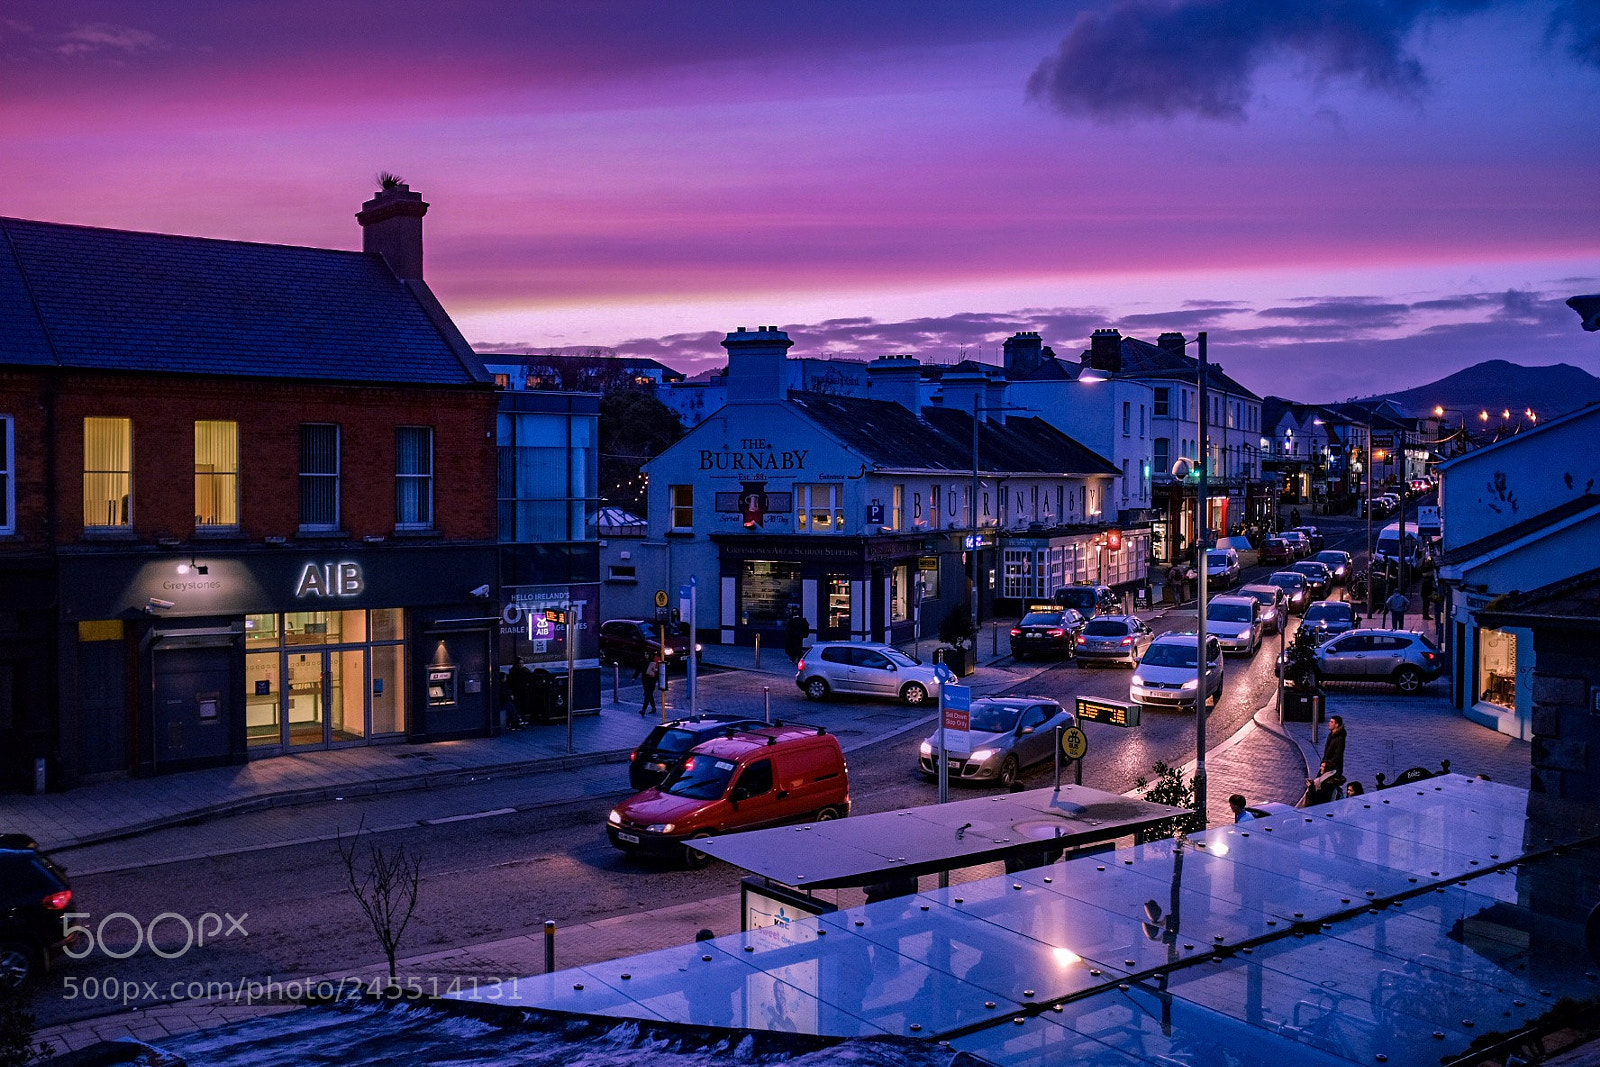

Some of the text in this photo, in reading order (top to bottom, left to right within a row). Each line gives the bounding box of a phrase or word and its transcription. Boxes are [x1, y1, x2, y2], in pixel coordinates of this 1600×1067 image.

[741, 438, 766, 449] THE
[698, 450, 808, 470] BURNABY
[914, 489, 1096, 519] BURNABY
[871, 506, 880, 517] P
[720, 514, 740, 523] Served
[162, 580, 221, 591] Greystones
[296, 562, 365, 598] AIB
[535, 592, 570, 600] IRELAND'S
